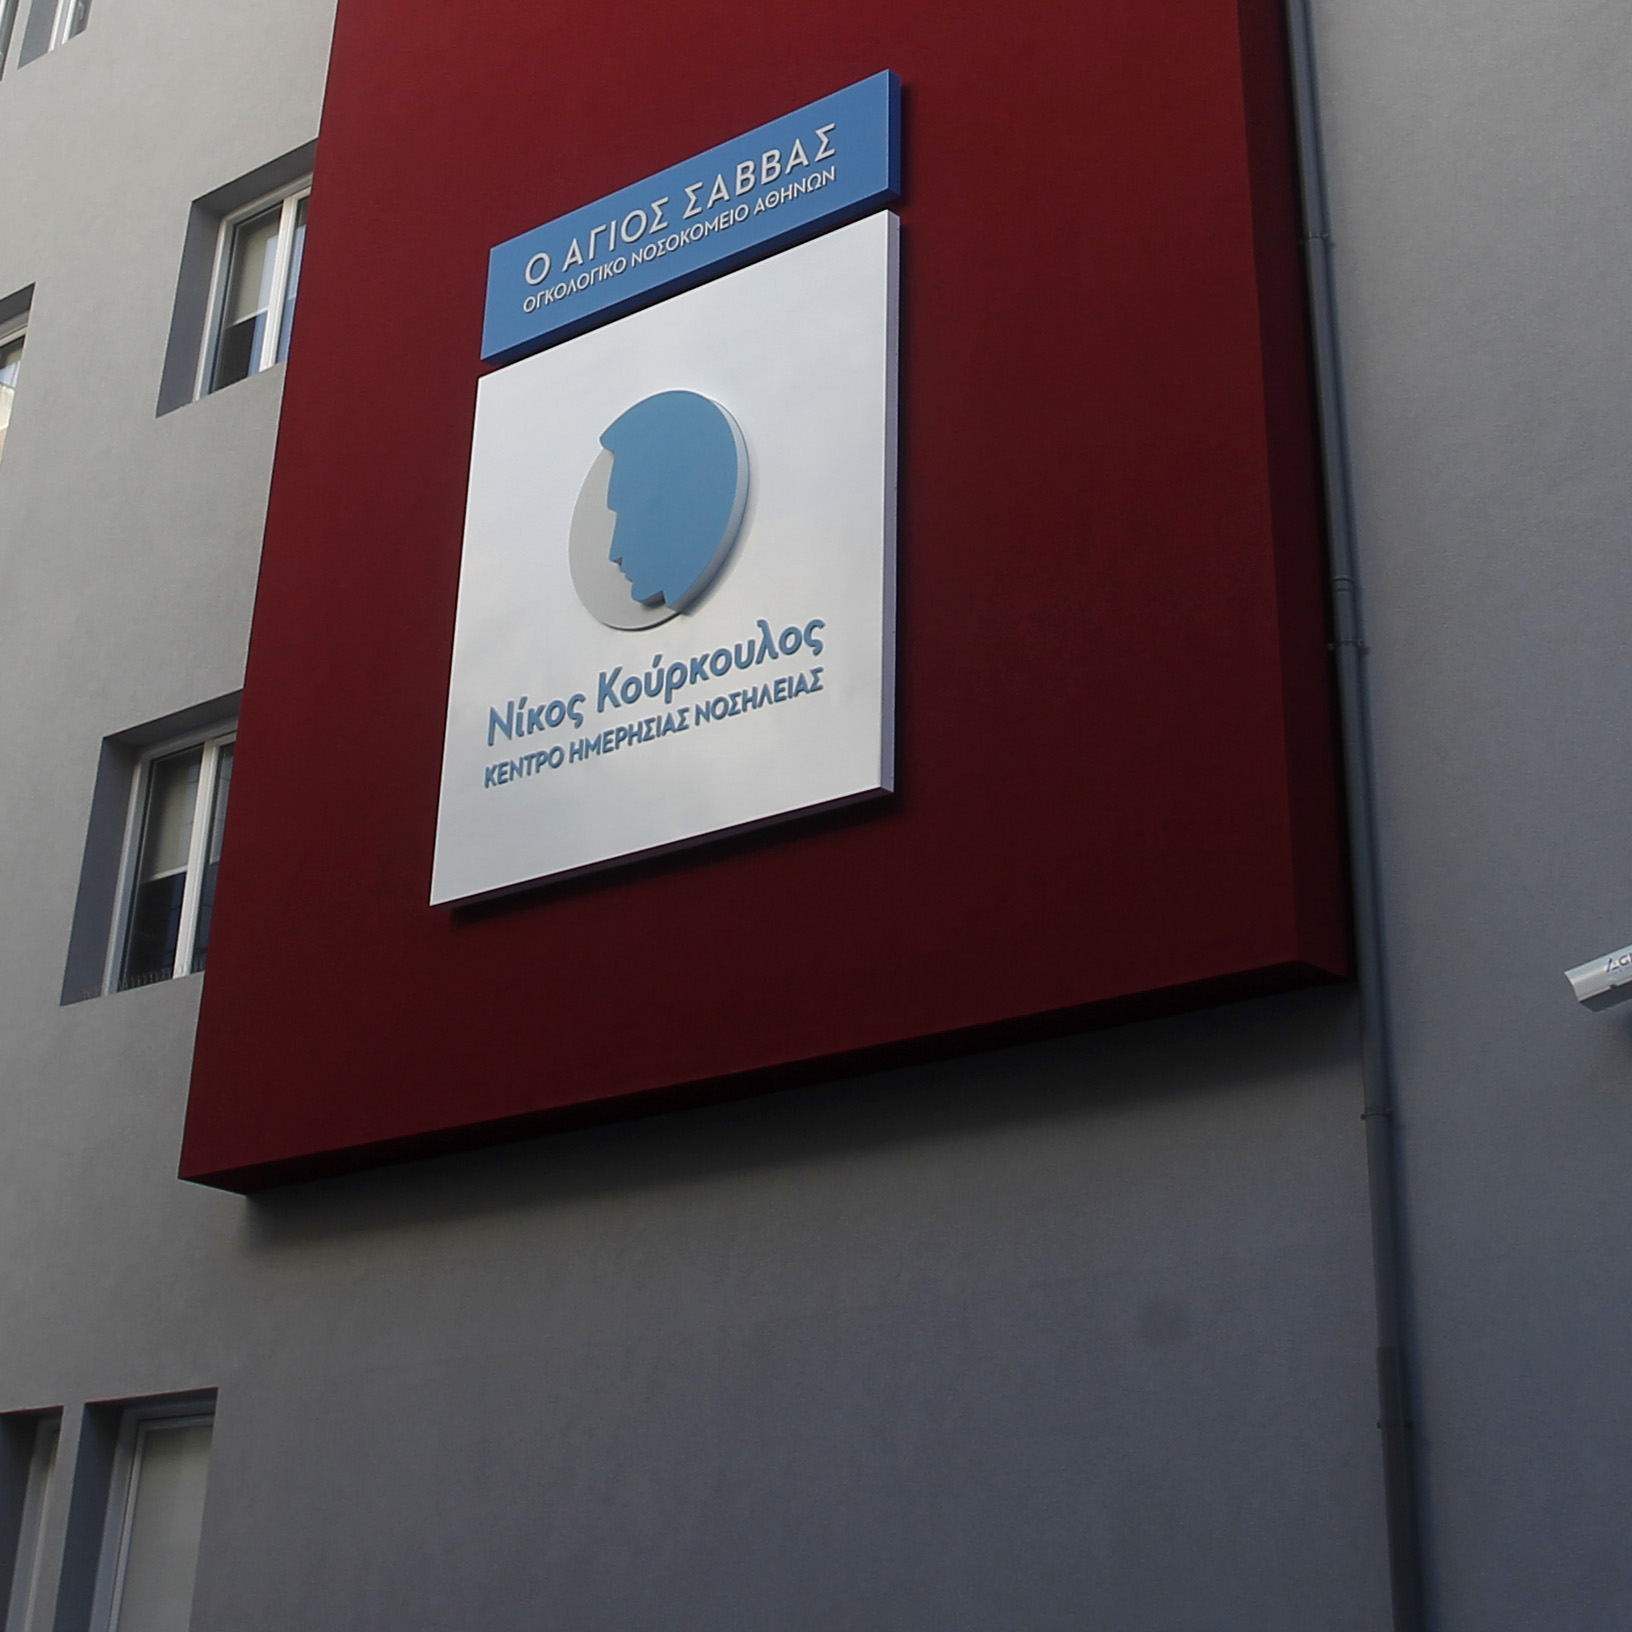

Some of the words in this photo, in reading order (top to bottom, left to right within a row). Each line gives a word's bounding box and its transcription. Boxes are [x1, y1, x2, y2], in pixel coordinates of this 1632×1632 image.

[522, 256, 627, 313] ΟΓΚΟΛΟΓΙΚΟ
[631, 203, 750, 267] ΝΟΣΟΚΟΜΕΙΟ
[752, 166, 836, 215] ΑΘΗΝΩΝ
[523, 252, 551, 286] Ο
[562, 197, 669, 272] ΑΓΙΟΣ
[681, 122, 837, 221] ΣΑΒΒΑΣ
[483, 744, 565, 789] ΚΕΝΤΡΟ
[568, 707, 690, 765] ΗΜΕΡΗΣΙΑΣ
[694, 666, 824, 727] ΝΟΣΗΛΕΙΑΣ
[487, 691, 586, 746] Νίκος
[596, 618, 825, 713] Κούρκουλος
